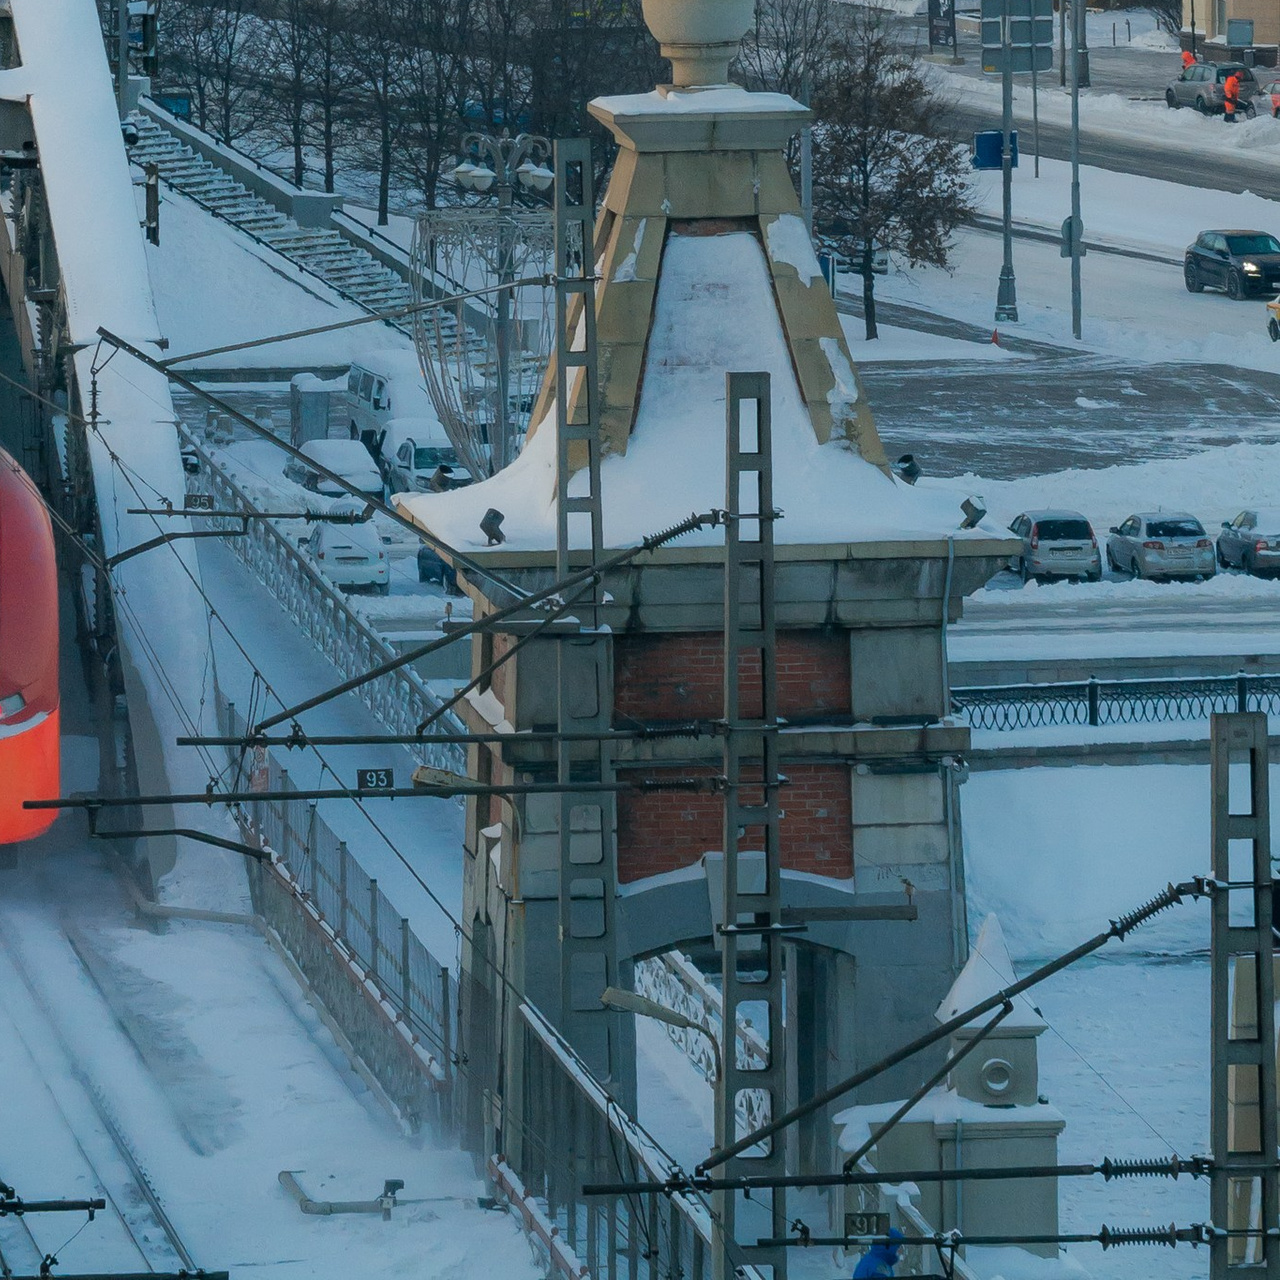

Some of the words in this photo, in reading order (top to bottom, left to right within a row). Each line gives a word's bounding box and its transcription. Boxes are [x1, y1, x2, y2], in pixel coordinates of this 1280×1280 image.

[192, 496, 209, 510] 95
[366, 771, 387, 787] 93
[855, 1215, 877, 1235] 91
